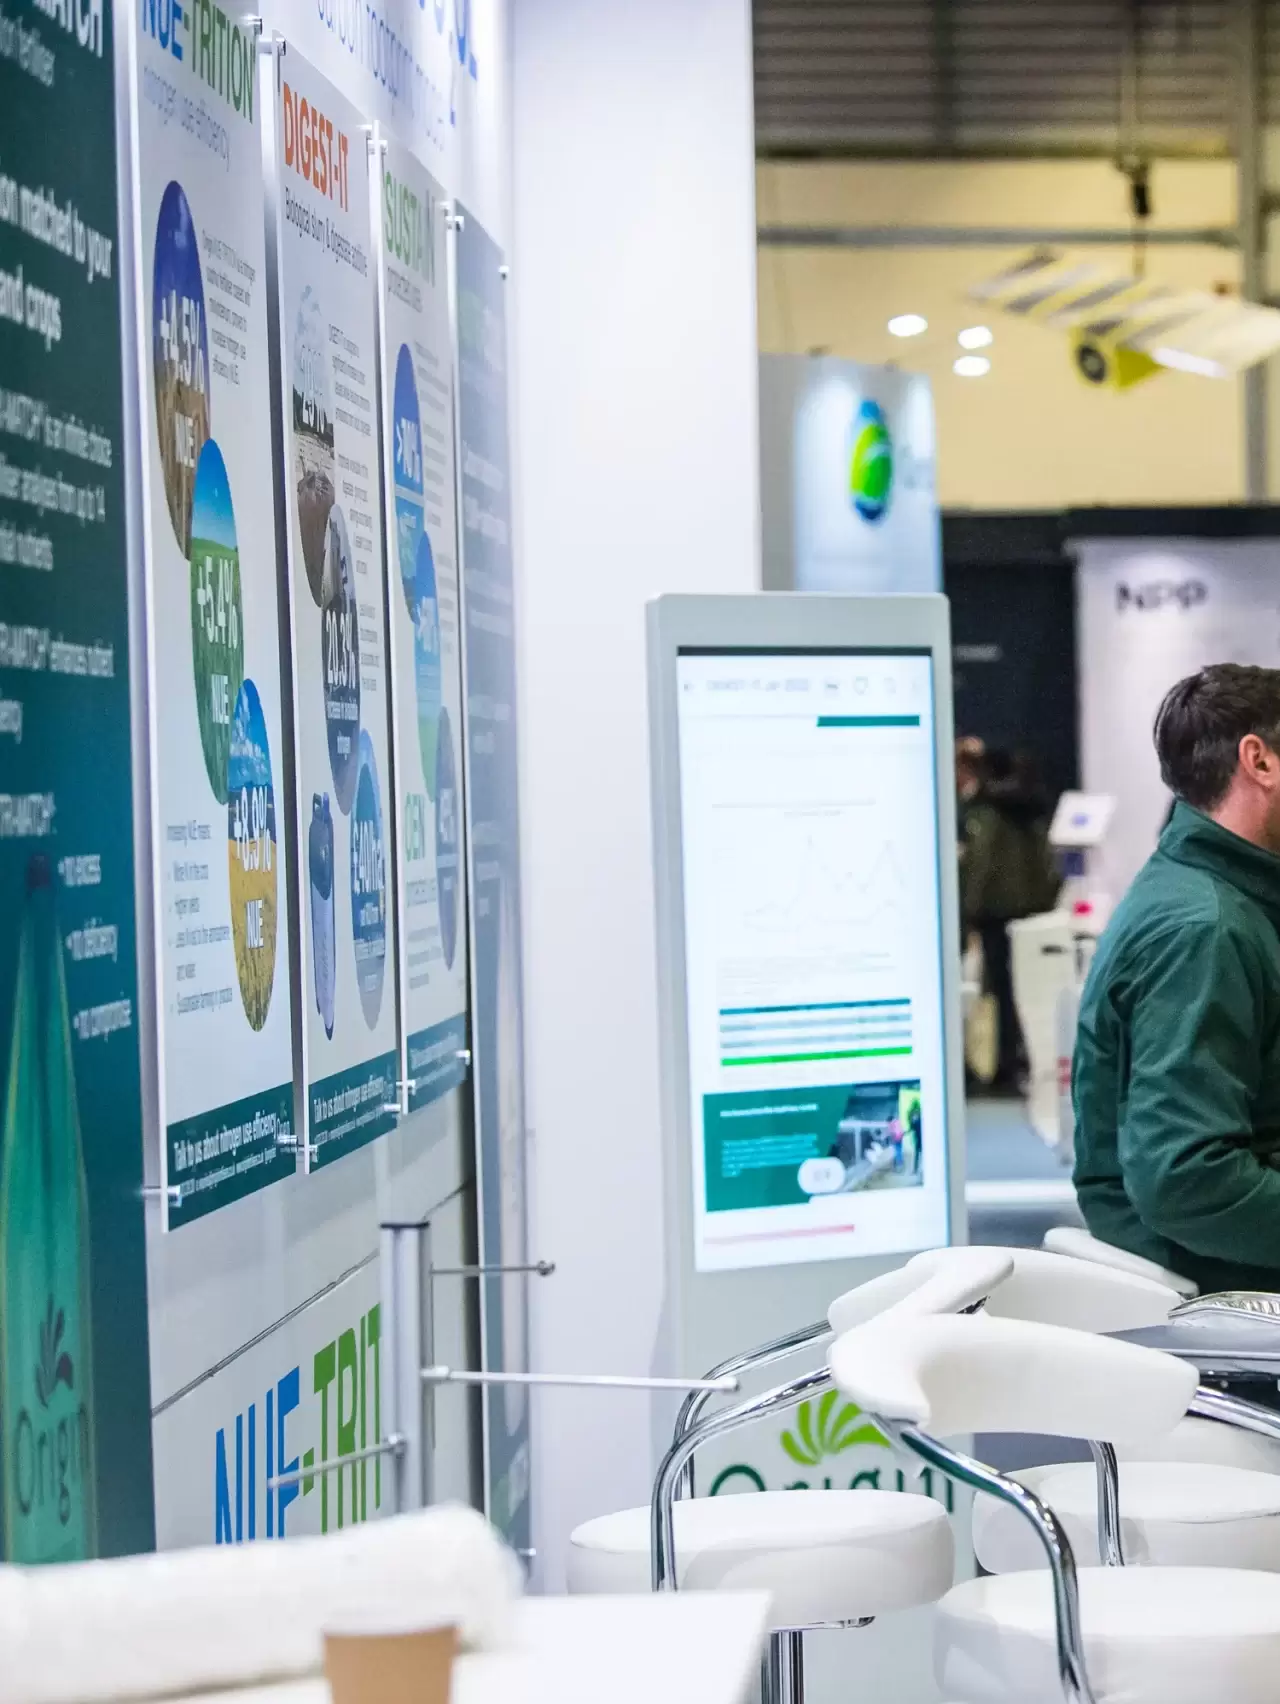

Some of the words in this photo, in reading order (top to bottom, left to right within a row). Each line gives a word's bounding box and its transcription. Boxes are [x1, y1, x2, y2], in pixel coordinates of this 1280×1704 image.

[283, 81, 348, 212] DIGEST-IT
[197, 553, 238, 650] +5.4%
[212, 671, 229, 728] NUE
[234, 785, 271, 872] +8.9%
[247, 900, 264, 949] NUE
[174, 1138, 186, 1172] Talk
[187, 1138, 193, 1168] to
[195, 1140, 202, 1164] us
[203, 1129, 219, 1160] about
[220, 1124, 241, 1157] nitrogen
[243, 1123, 252, 1144] use
[253, 1110, 276, 1141] efficiency
